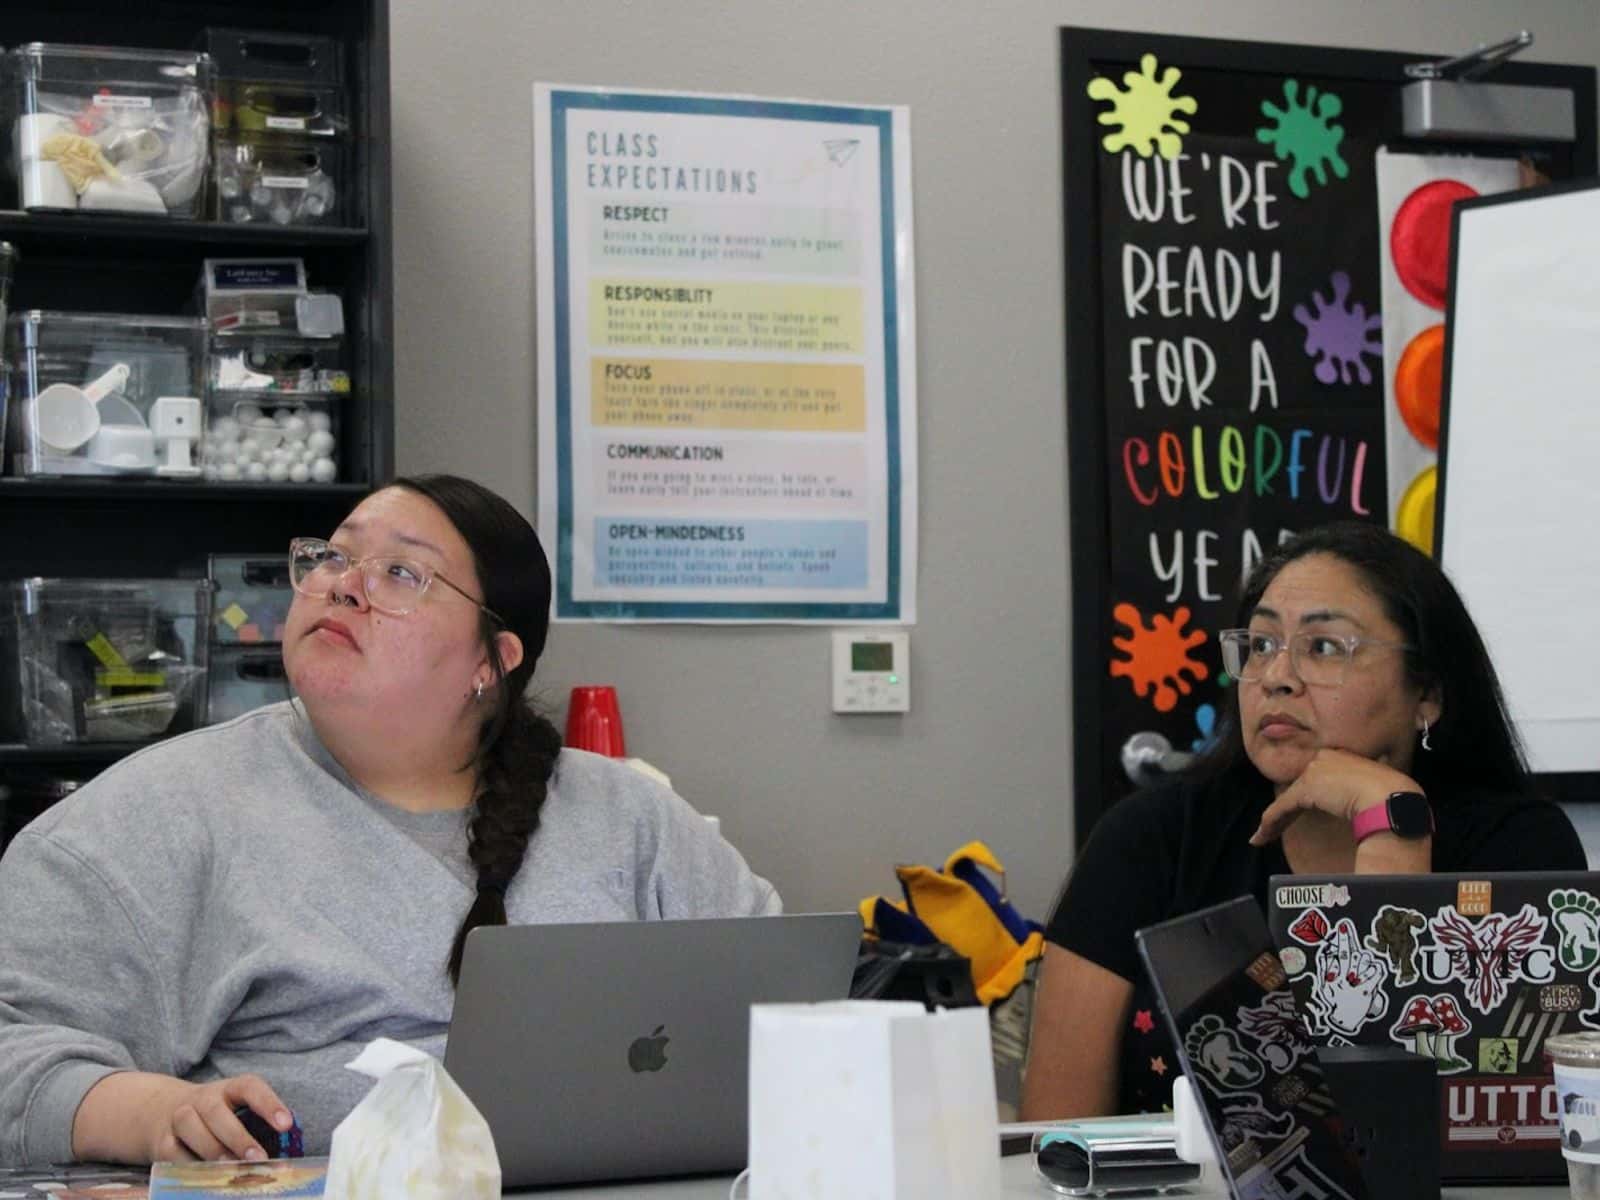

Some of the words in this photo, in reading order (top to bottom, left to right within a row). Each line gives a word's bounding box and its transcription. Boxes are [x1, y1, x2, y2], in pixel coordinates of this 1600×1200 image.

[587, 131, 658, 157] CLASS
[587, 164, 757, 194] EXPECTATIONS
[1121, 152, 1280, 230] WE'RE
[603, 205, 669, 222] RESPECT
[605, 286, 713, 303] RESPONSIBLITY
[1122, 243, 1281, 322] READY
[605, 364, 653, 380] FOCUS
[1129, 337, 1215, 410] FOR
[1249, 339, 1280, 412] A
[607, 444, 723, 461] COMMUNICATION
[1122, 425, 1371, 515] COLORFUL
[609, 524, 745, 541] OPEN-MINDEDNESS
[1149, 528, 1296, 603] YEA
[1278, 886, 1325, 905] CHOOSE
[1423, 949, 1552, 980] UTTC
[1544, 997, 1577, 1007] BUSY
